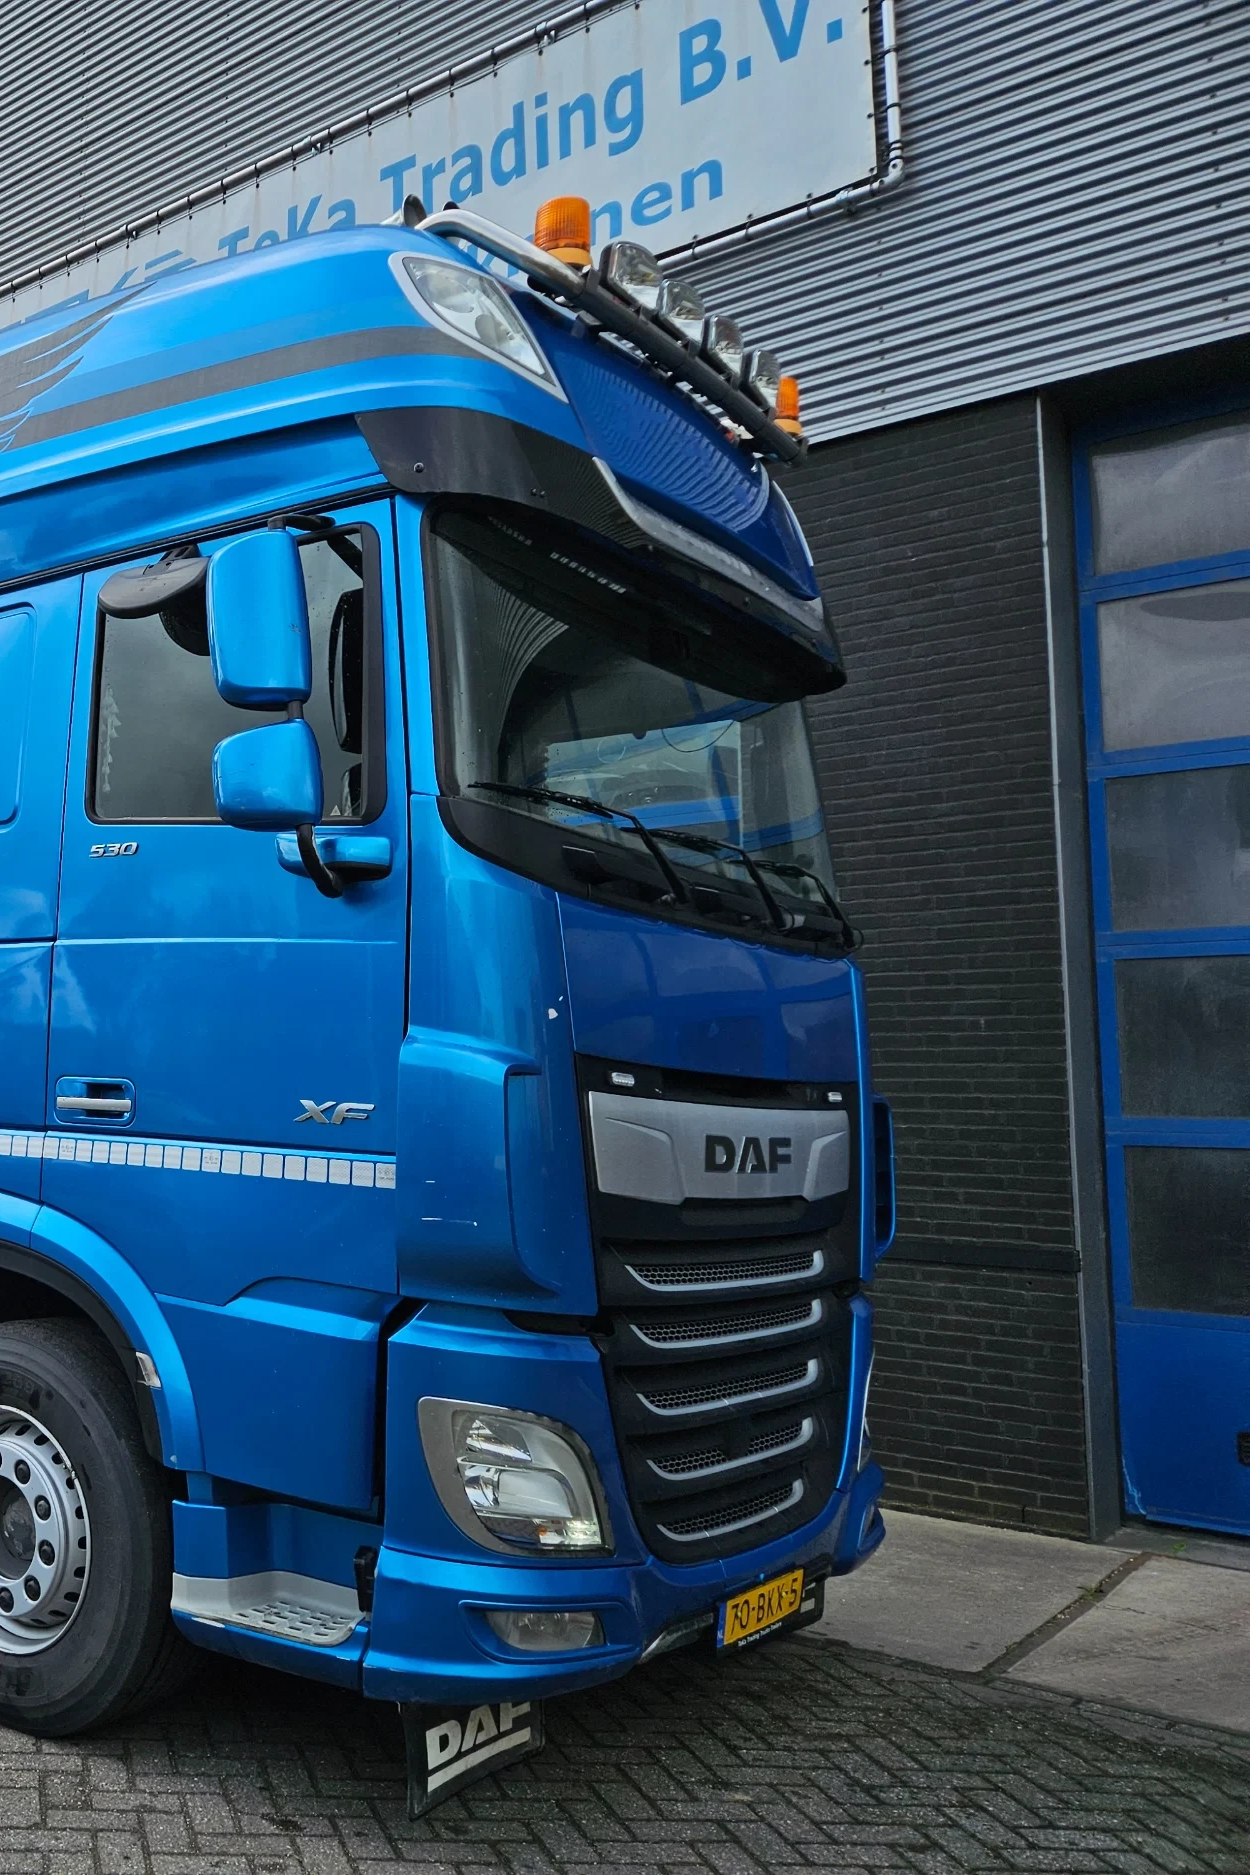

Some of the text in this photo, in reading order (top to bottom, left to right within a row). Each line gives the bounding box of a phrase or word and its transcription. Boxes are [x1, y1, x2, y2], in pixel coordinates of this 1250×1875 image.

[379, 67, 645, 216] Trading
[678, 0, 844, 106] B.V.
[89, 842, 138, 858] 530
[293, 1099, 375, 1125] XF
[704, 1133, 792, 1174] DAF
[730, 1577, 799, 1637] 70-BKX-5
[425, 1701, 531, 1771] DAF
